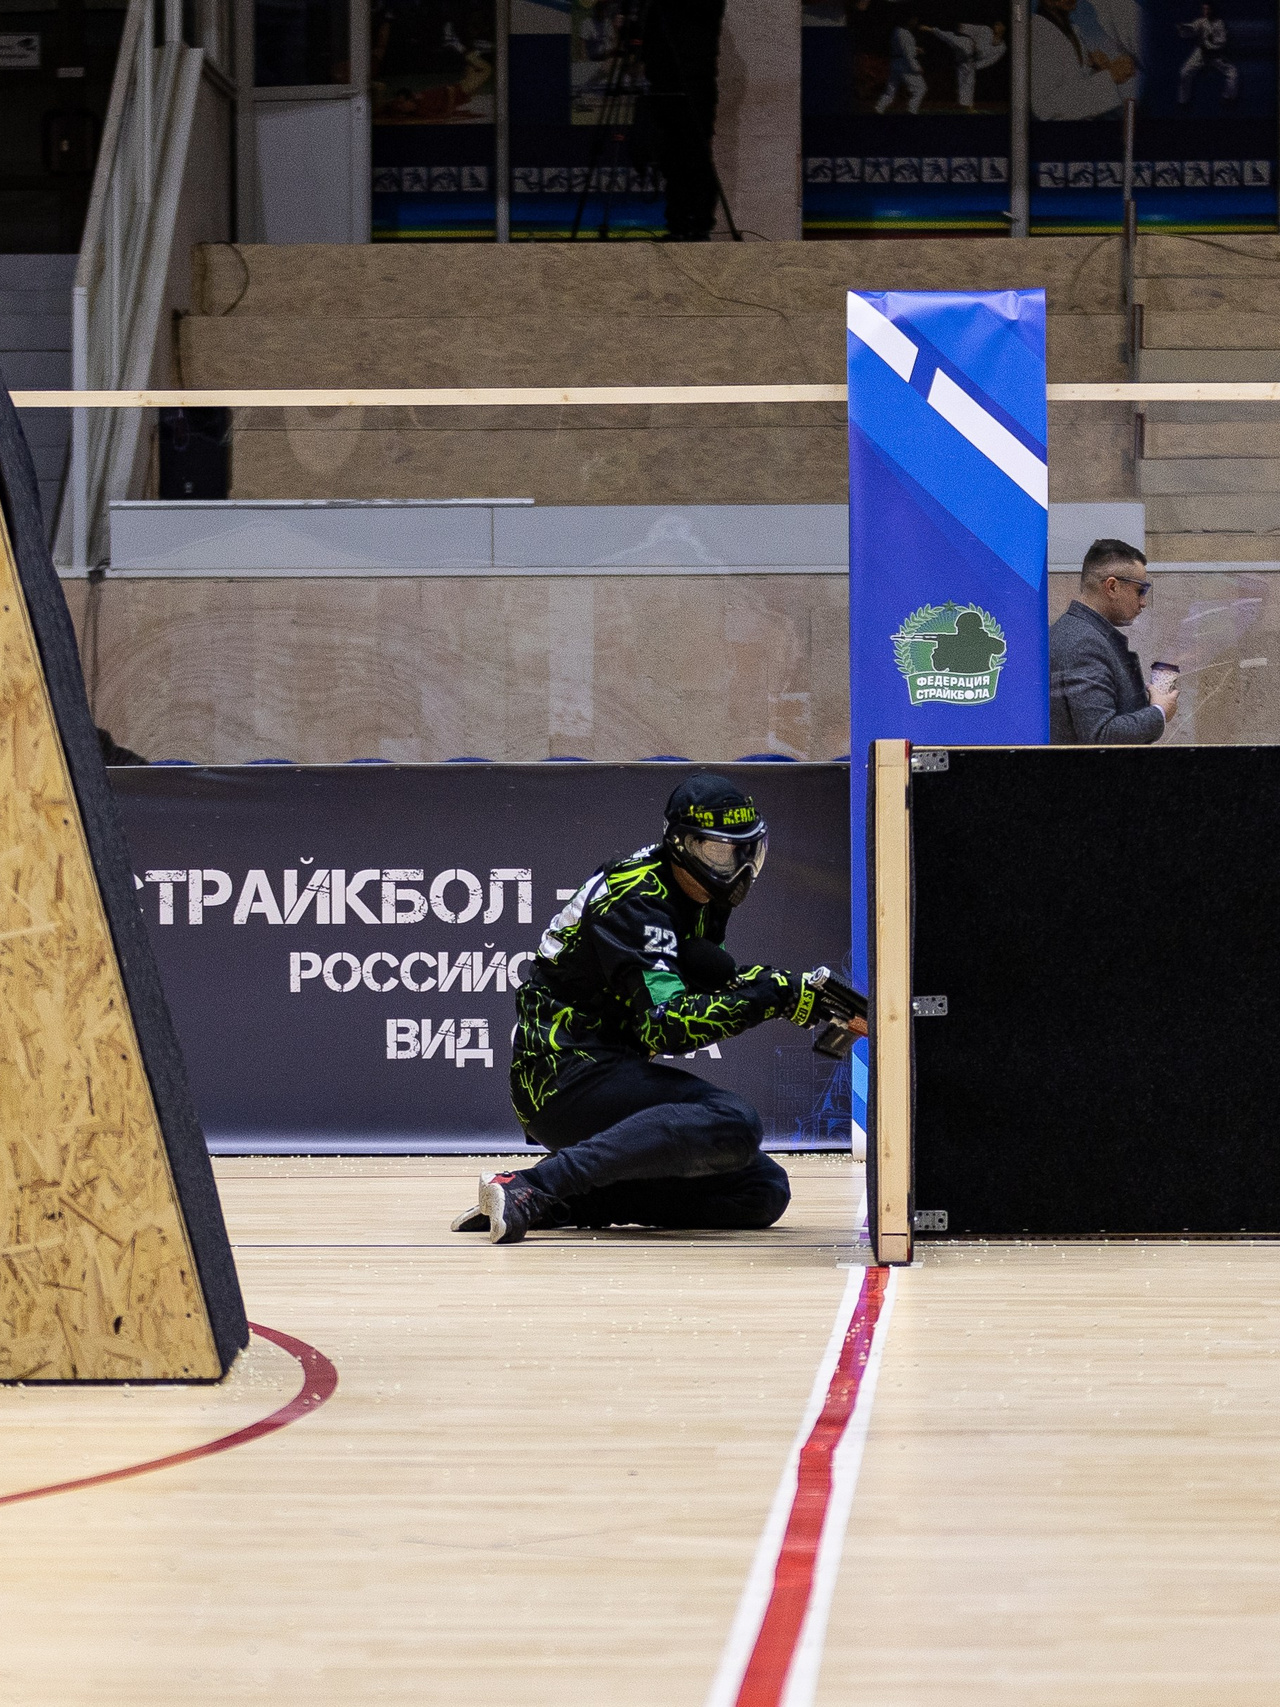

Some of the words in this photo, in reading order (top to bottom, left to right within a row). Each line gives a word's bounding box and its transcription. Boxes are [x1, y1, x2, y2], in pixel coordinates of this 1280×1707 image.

[916, 675, 991, 689] ФЕДЕРАЦИЯ
[916, 687, 991, 700] СТРАЙКБОЛА
[134, 856, 533, 926] ТРАЙКБОЛ
[643, 924, 678, 958] 22
[386, 1018, 494, 1068] ВИД
